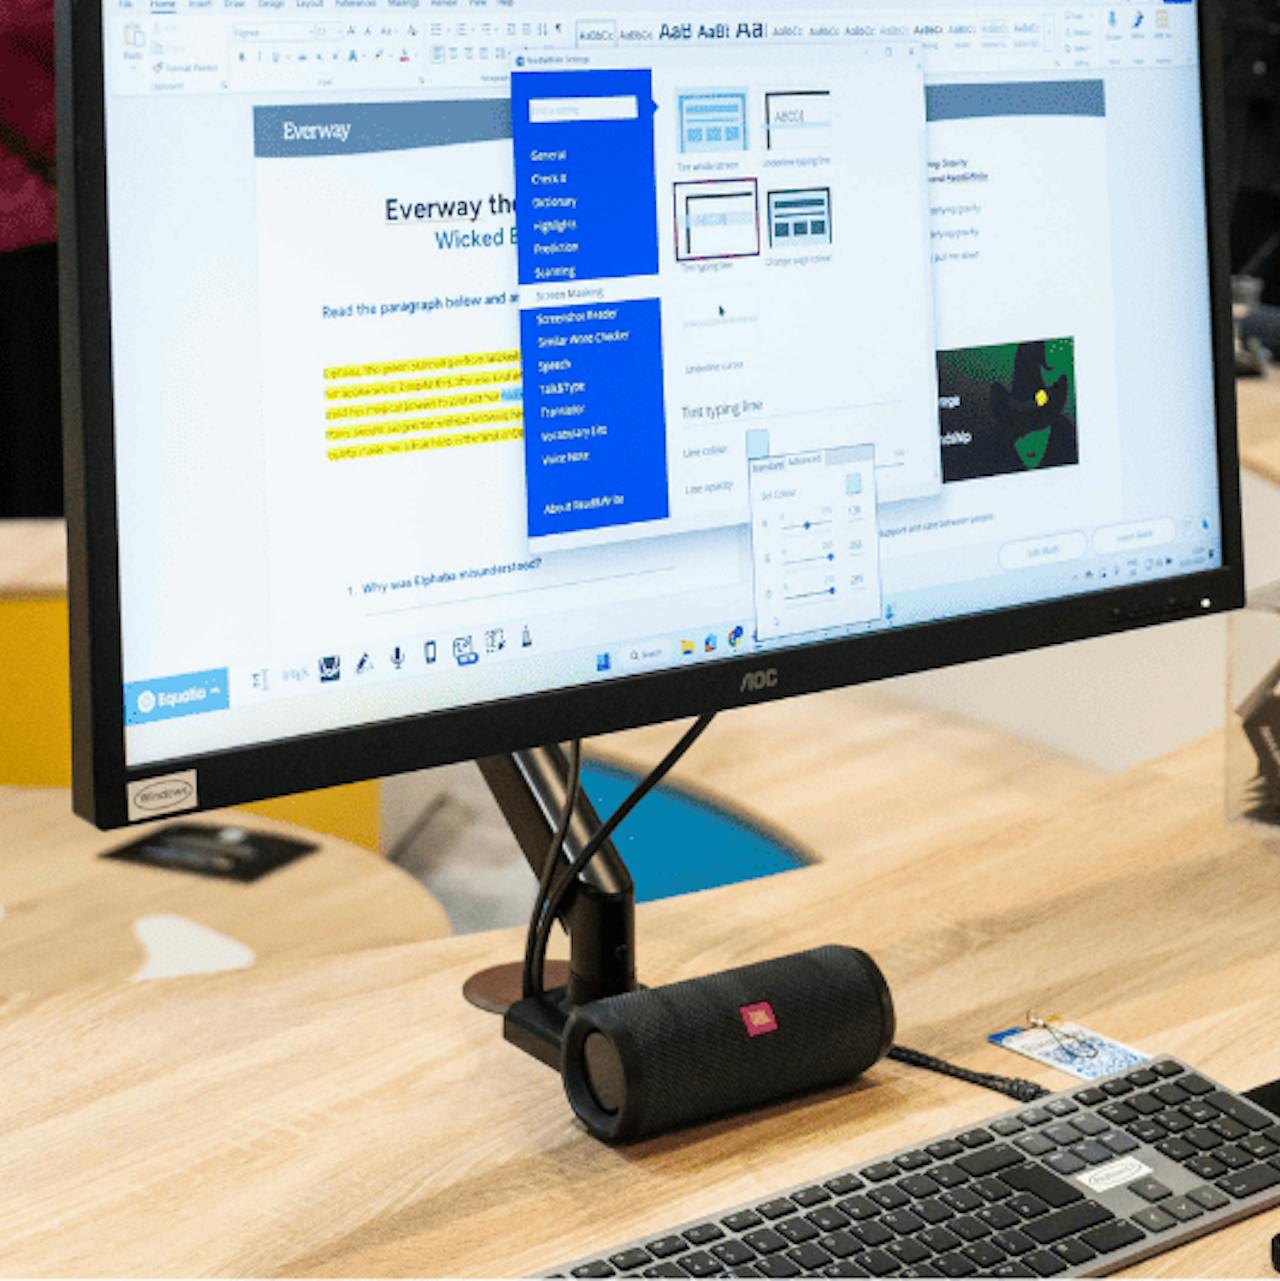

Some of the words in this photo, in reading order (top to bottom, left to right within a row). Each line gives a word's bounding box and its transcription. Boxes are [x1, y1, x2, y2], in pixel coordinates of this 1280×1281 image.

[283, 120, 352, 142] Everway
[385, 195, 483, 221] Everway
[434, 228, 504, 250] Wicked
[322, 304, 353, 320] Read
[356, 302, 377, 316] the
[380, 297, 443, 318] paragraph
[445, 293, 482, 309] below
[484, 292, 506, 307] and
[705, 402, 741, 421] typing
[741, 399, 763, 413] line
[362, 580, 389, 596] Why
[390, 579, 412, 591] was
[414, 570, 457, 589] Elphaba
[458, 556, 543, 579] misunderstood?
[740, 667, 779, 693] AOC
